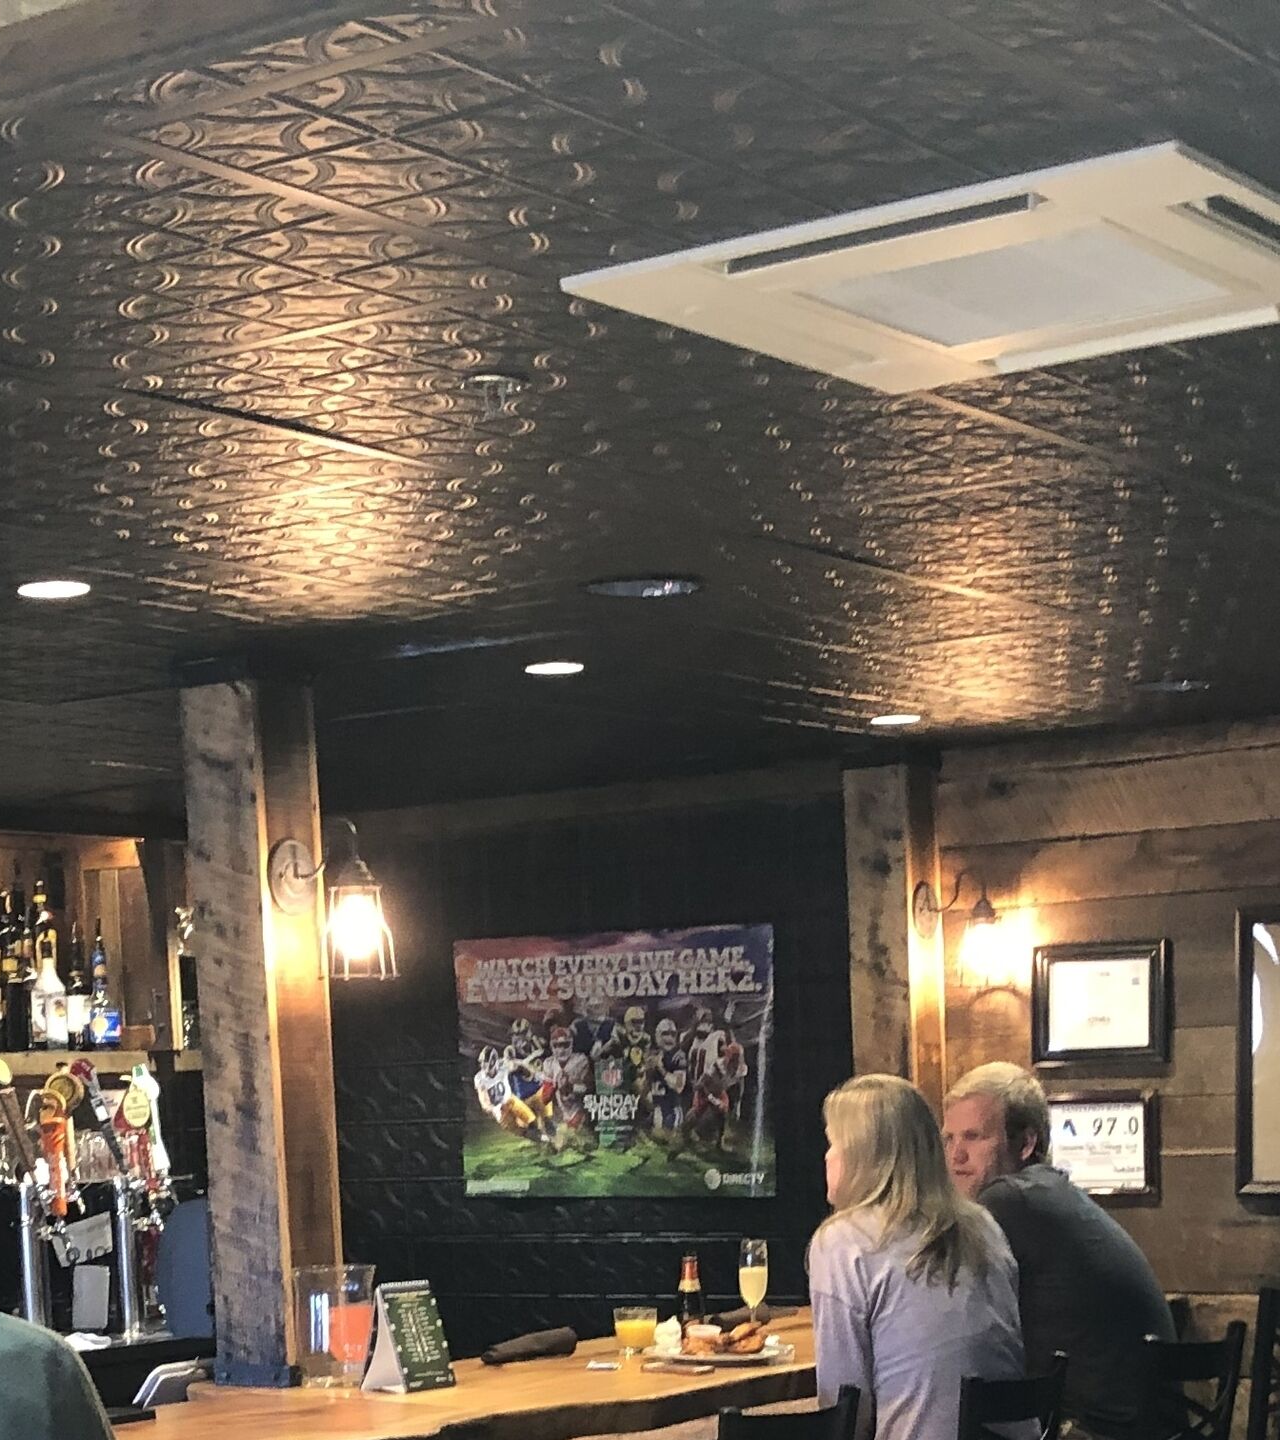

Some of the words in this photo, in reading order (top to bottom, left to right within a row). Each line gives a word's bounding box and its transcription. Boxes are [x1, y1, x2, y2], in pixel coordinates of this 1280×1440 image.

[477, 956, 552, 978] WATCH
[554, 952, 621, 976] EVERY
[621, 949, 675, 972] LIVE
[466, 976, 552, 1003] EVERY
[557, 970, 673, 1000] SUNDAY
[583, 1093, 641, 1110] SUNDAY
[587, 1106, 638, 1121] TICKET
